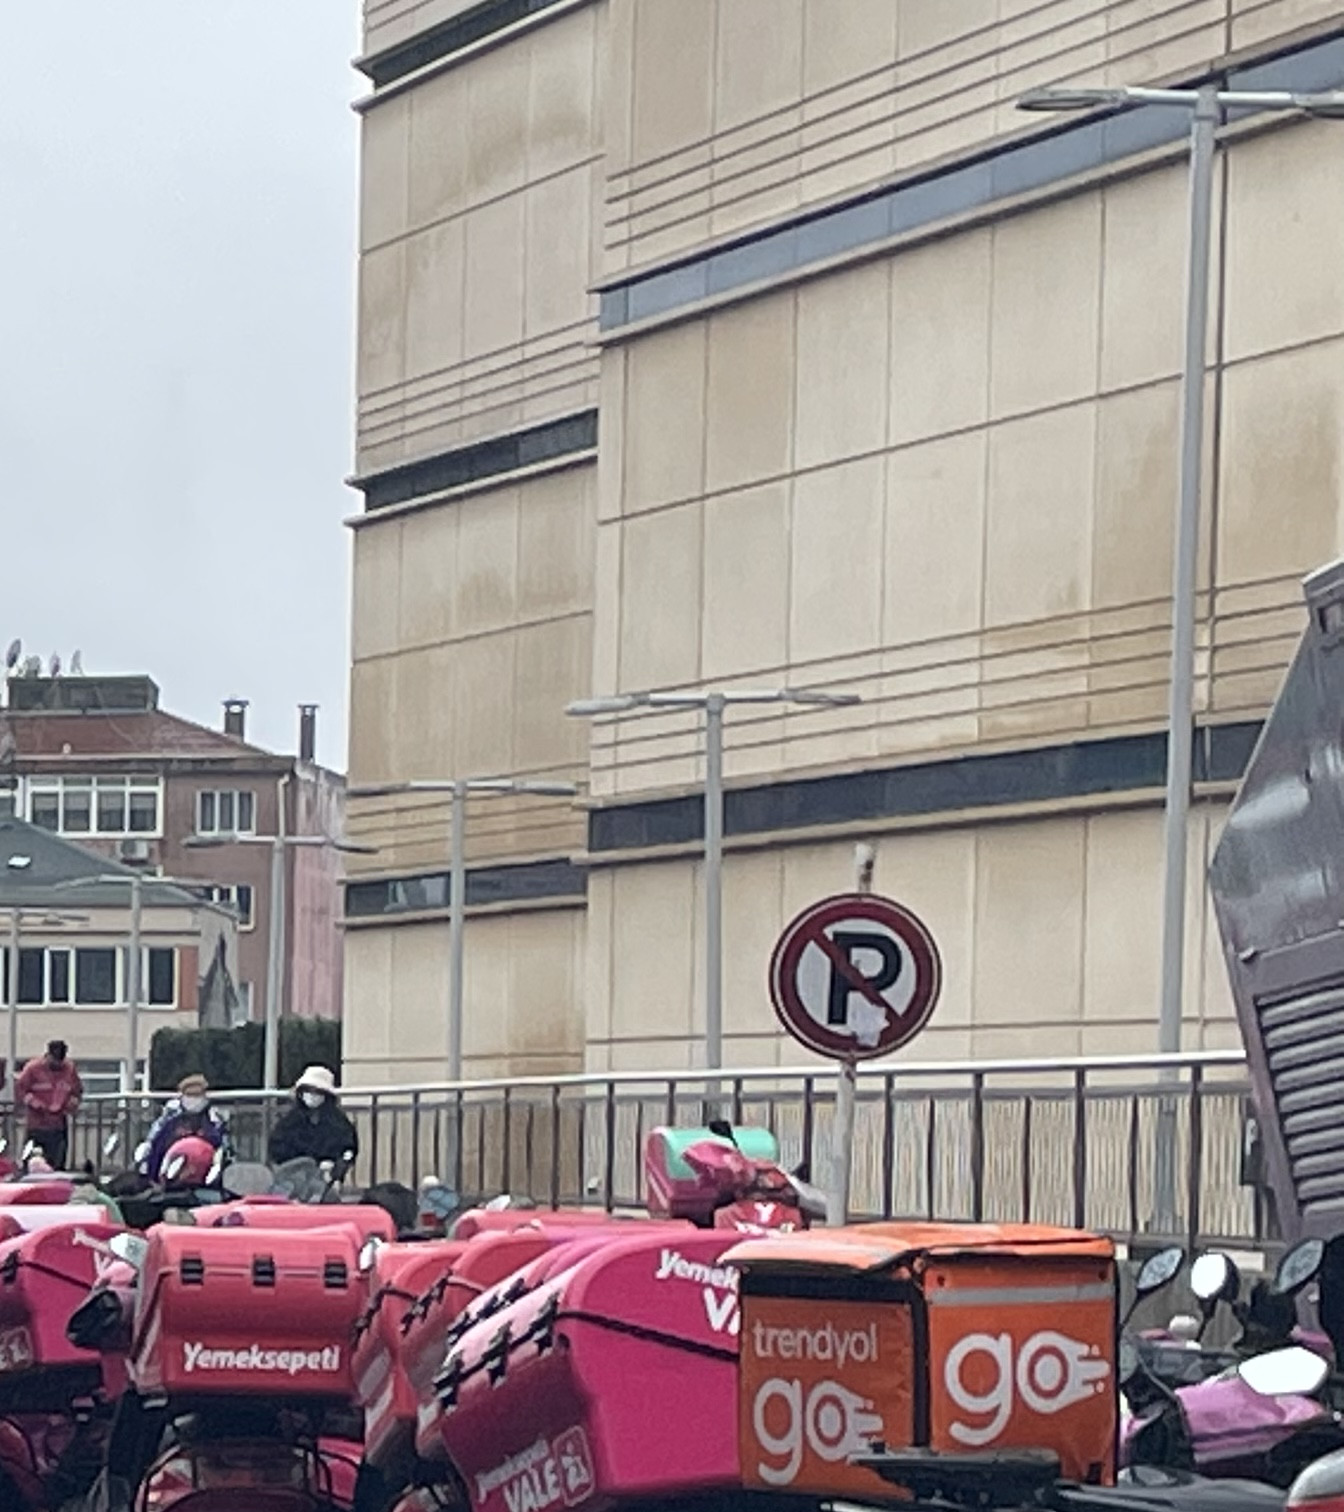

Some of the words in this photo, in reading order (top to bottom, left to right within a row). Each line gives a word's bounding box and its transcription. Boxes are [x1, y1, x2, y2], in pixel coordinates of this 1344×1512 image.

[183, 1341, 341, 1376] Yemeksepeti
[753, 1321, 879, 1369] trendyol
[944, 1331, 1110, 1446] go
[753, 1377, 885, 1486] go
